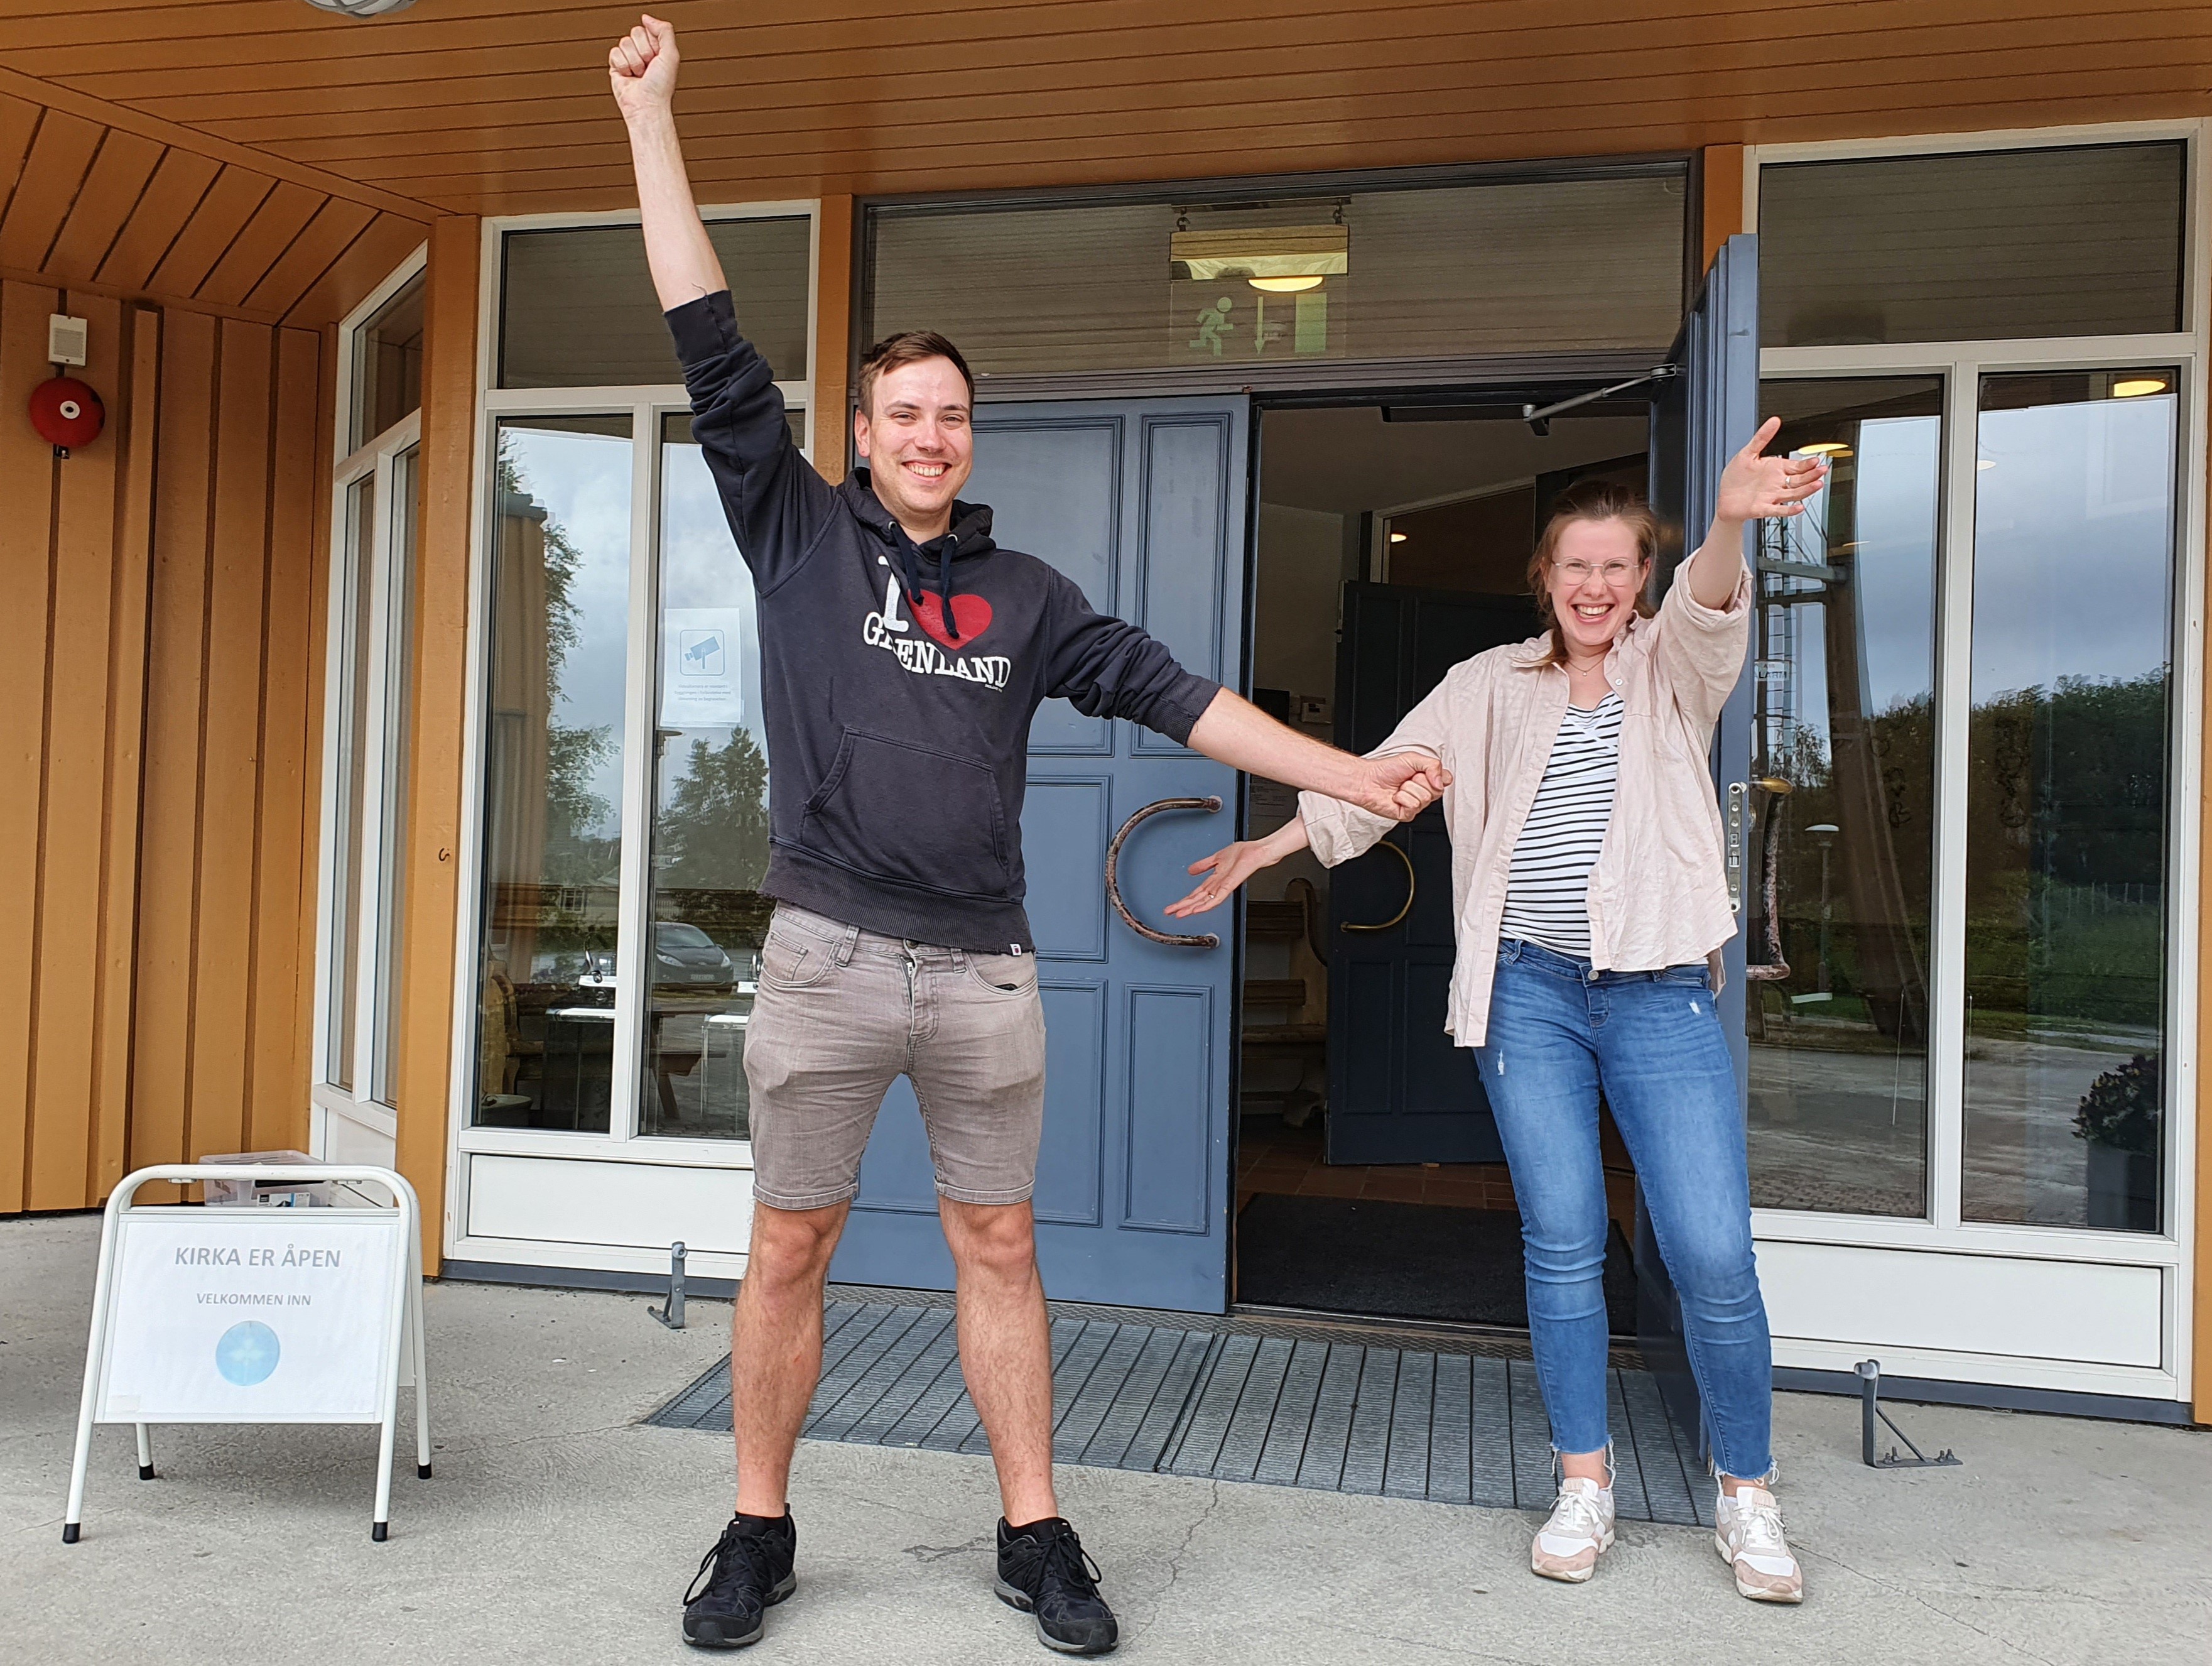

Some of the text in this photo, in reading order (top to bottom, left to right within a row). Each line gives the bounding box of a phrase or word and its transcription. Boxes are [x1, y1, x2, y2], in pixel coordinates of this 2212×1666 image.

[176, 1244, 340, 1267] KIRKA ER ÅPEN
[197, 1293, 310, 1305] VELKOMMEN INN
